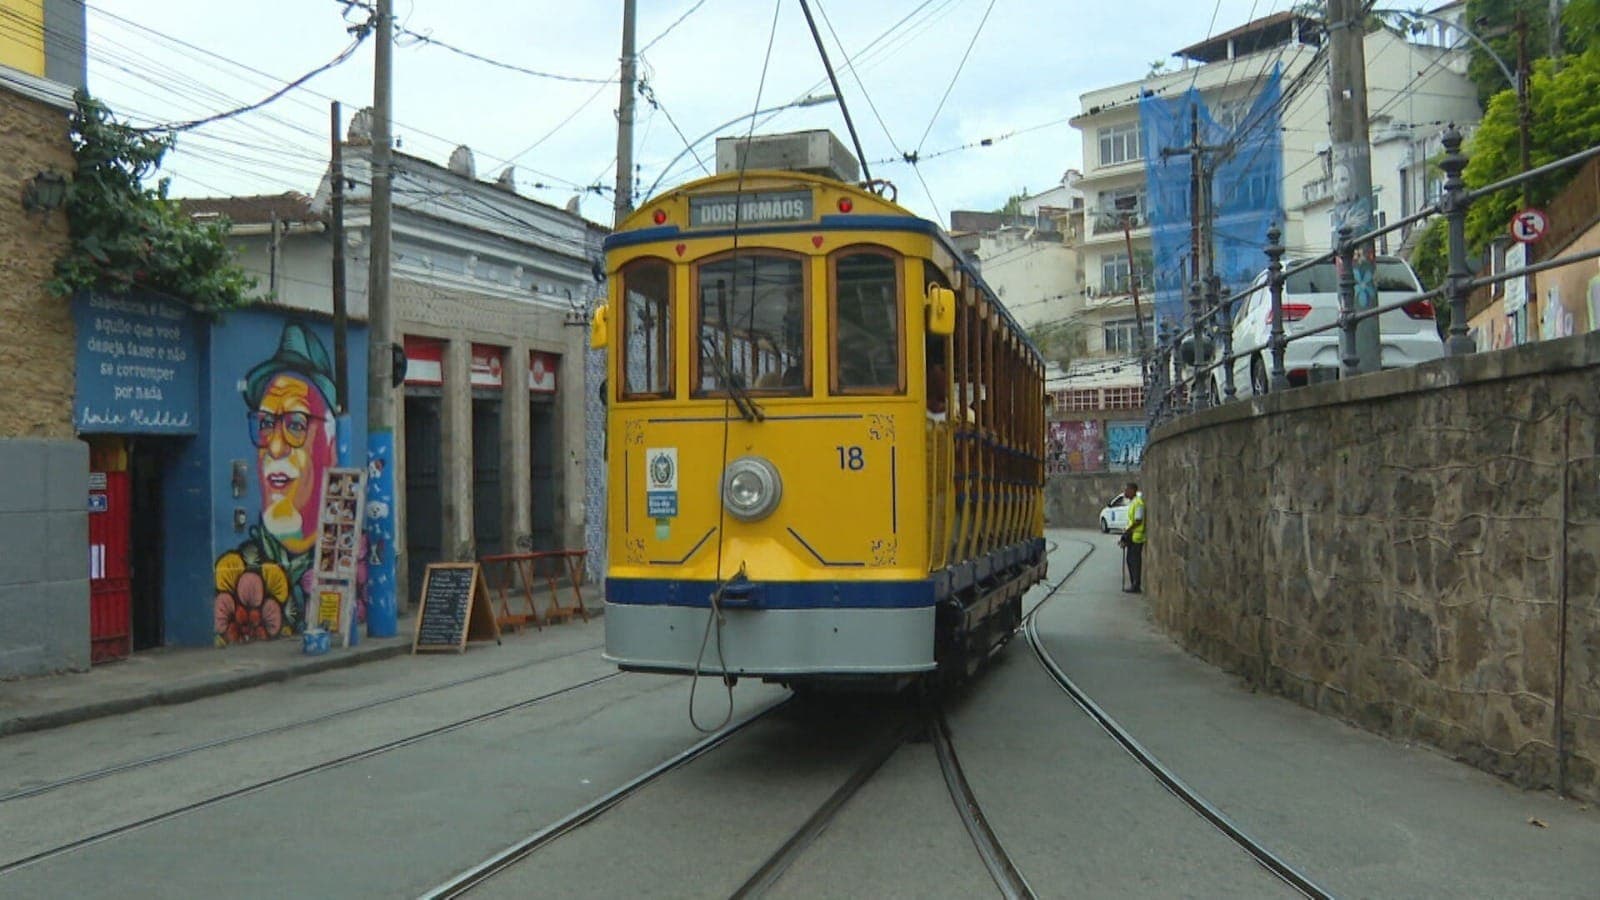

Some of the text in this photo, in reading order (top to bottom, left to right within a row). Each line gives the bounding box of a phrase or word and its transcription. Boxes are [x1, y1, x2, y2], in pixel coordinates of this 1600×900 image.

[701, 203, 737, 223] DOIS
[134, 324, 154, 339] que
[88, 336, 126, 358] deseja
[128, 342, 156, 359] fazer
[100, 362, 175, 382] se corromper
[114, 385, 163, 400] por nada
[836, 446, 864, 471] 18
